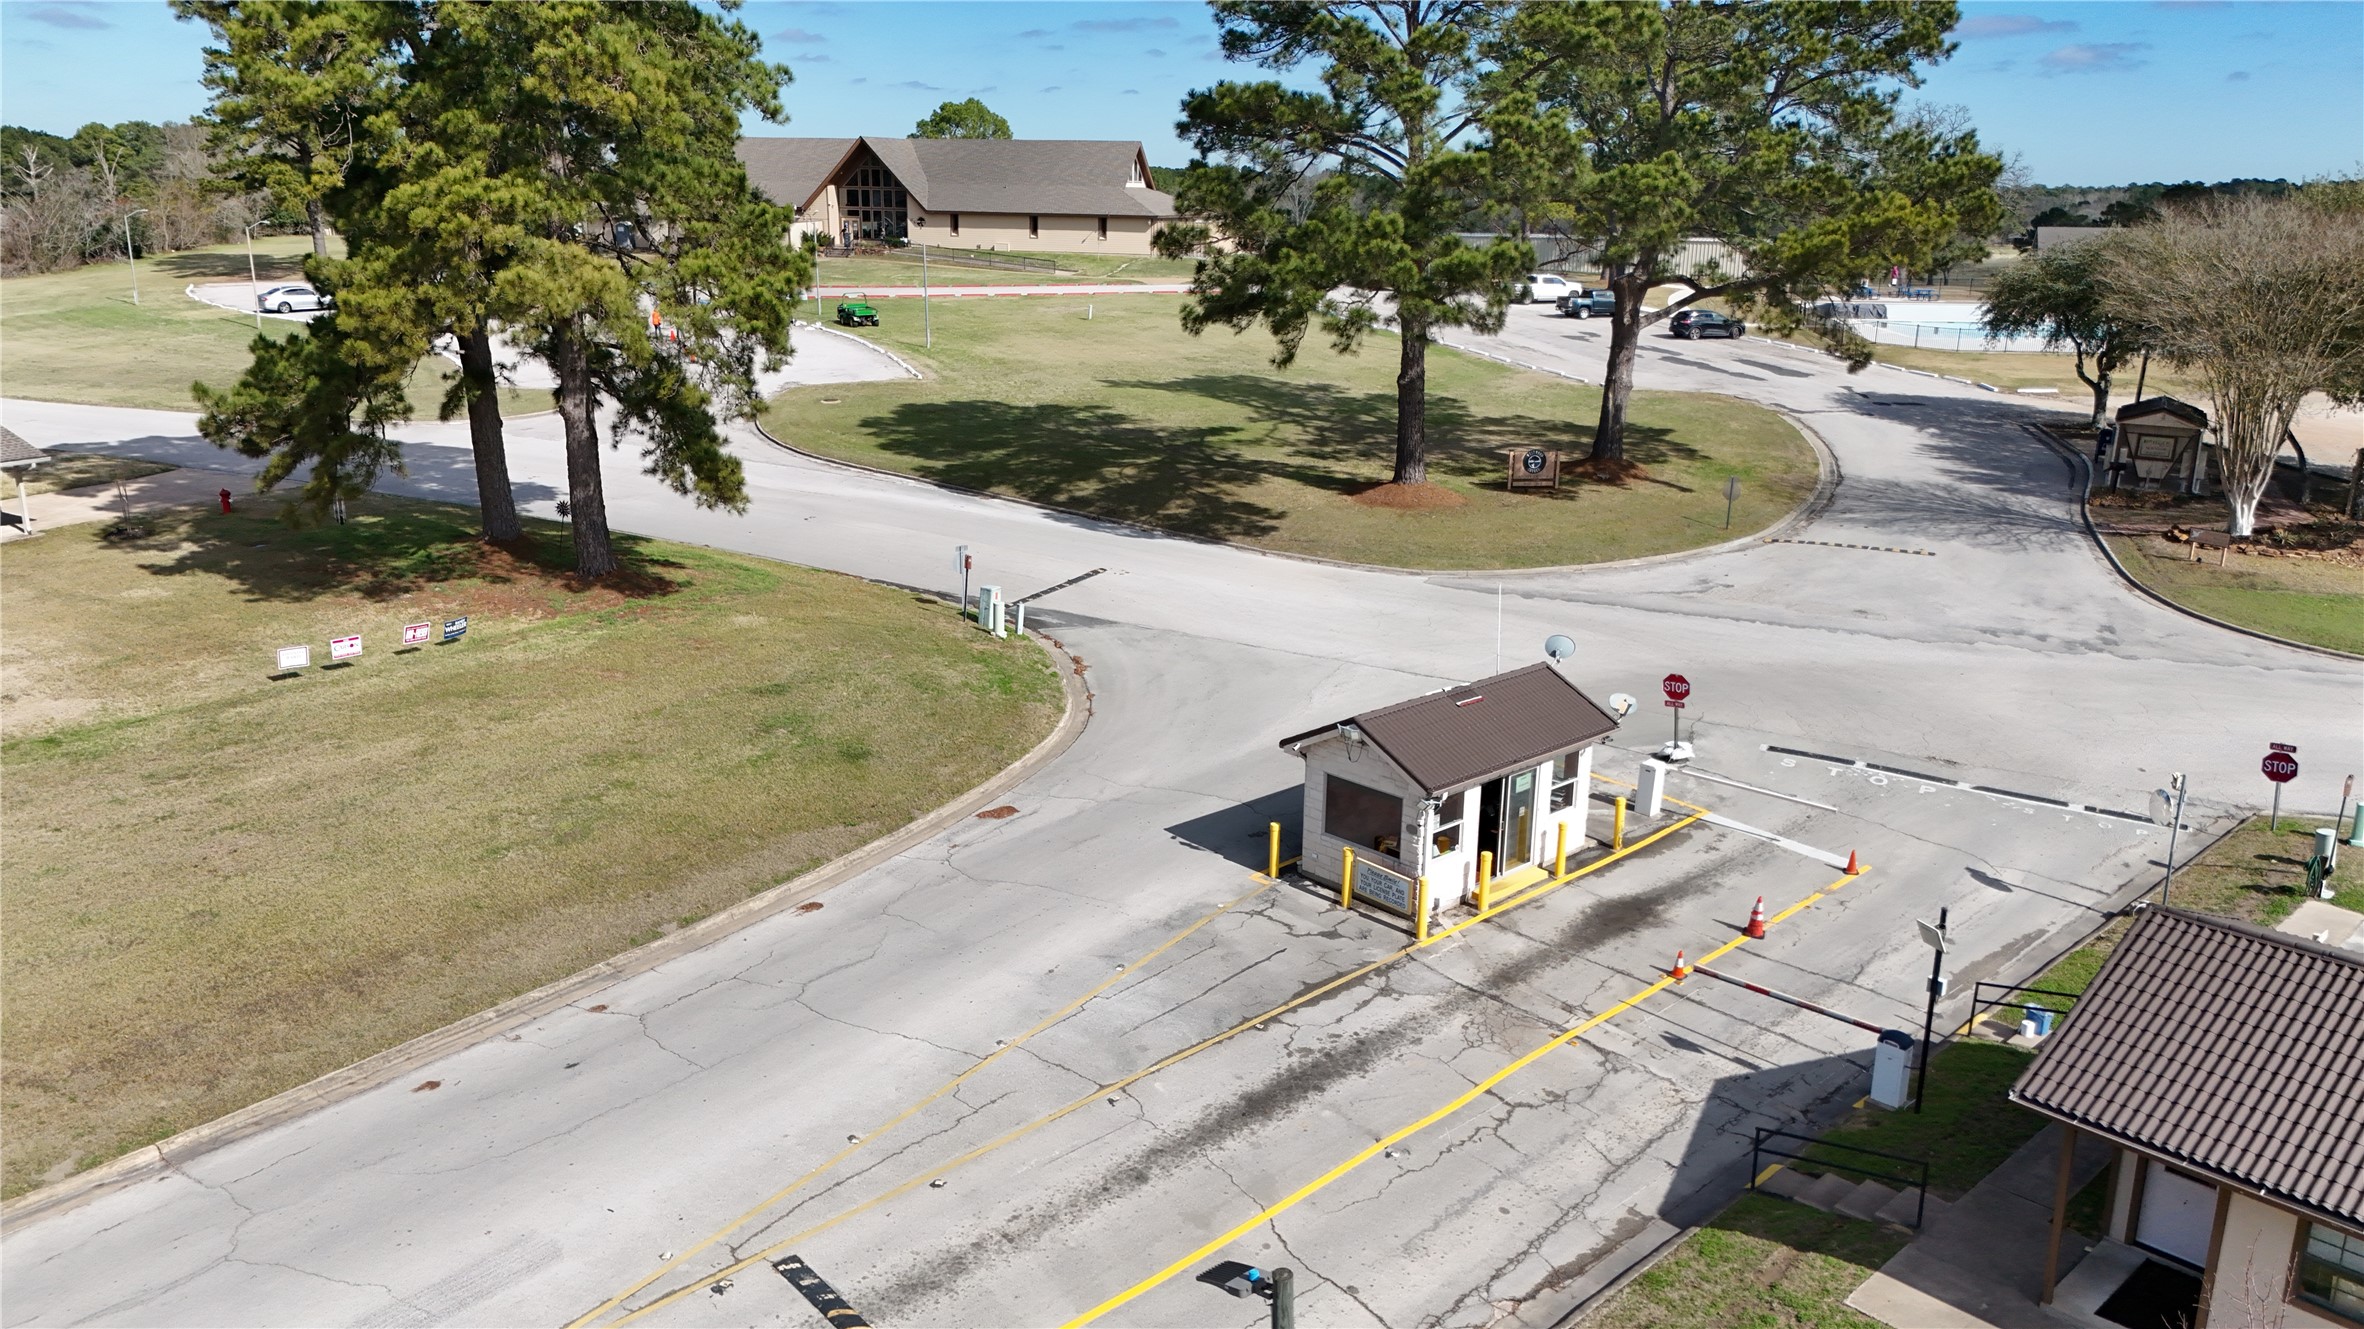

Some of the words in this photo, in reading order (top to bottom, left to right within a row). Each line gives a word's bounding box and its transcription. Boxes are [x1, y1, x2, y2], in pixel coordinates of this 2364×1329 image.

[1664, 681, 1689, 693] STOP
[2263, 760, 2296, 774] STOP
[1780, 757, 1937, 794] STOP
[1369, 889, 1382, 899] BEING
[1383, 894, 1406, 909] RECORDED
[1374, 884, 1390, 896] LICENSE
[1392, 892, 1405, 903] PLATE
[1395, 888, 1405, 896] AND
